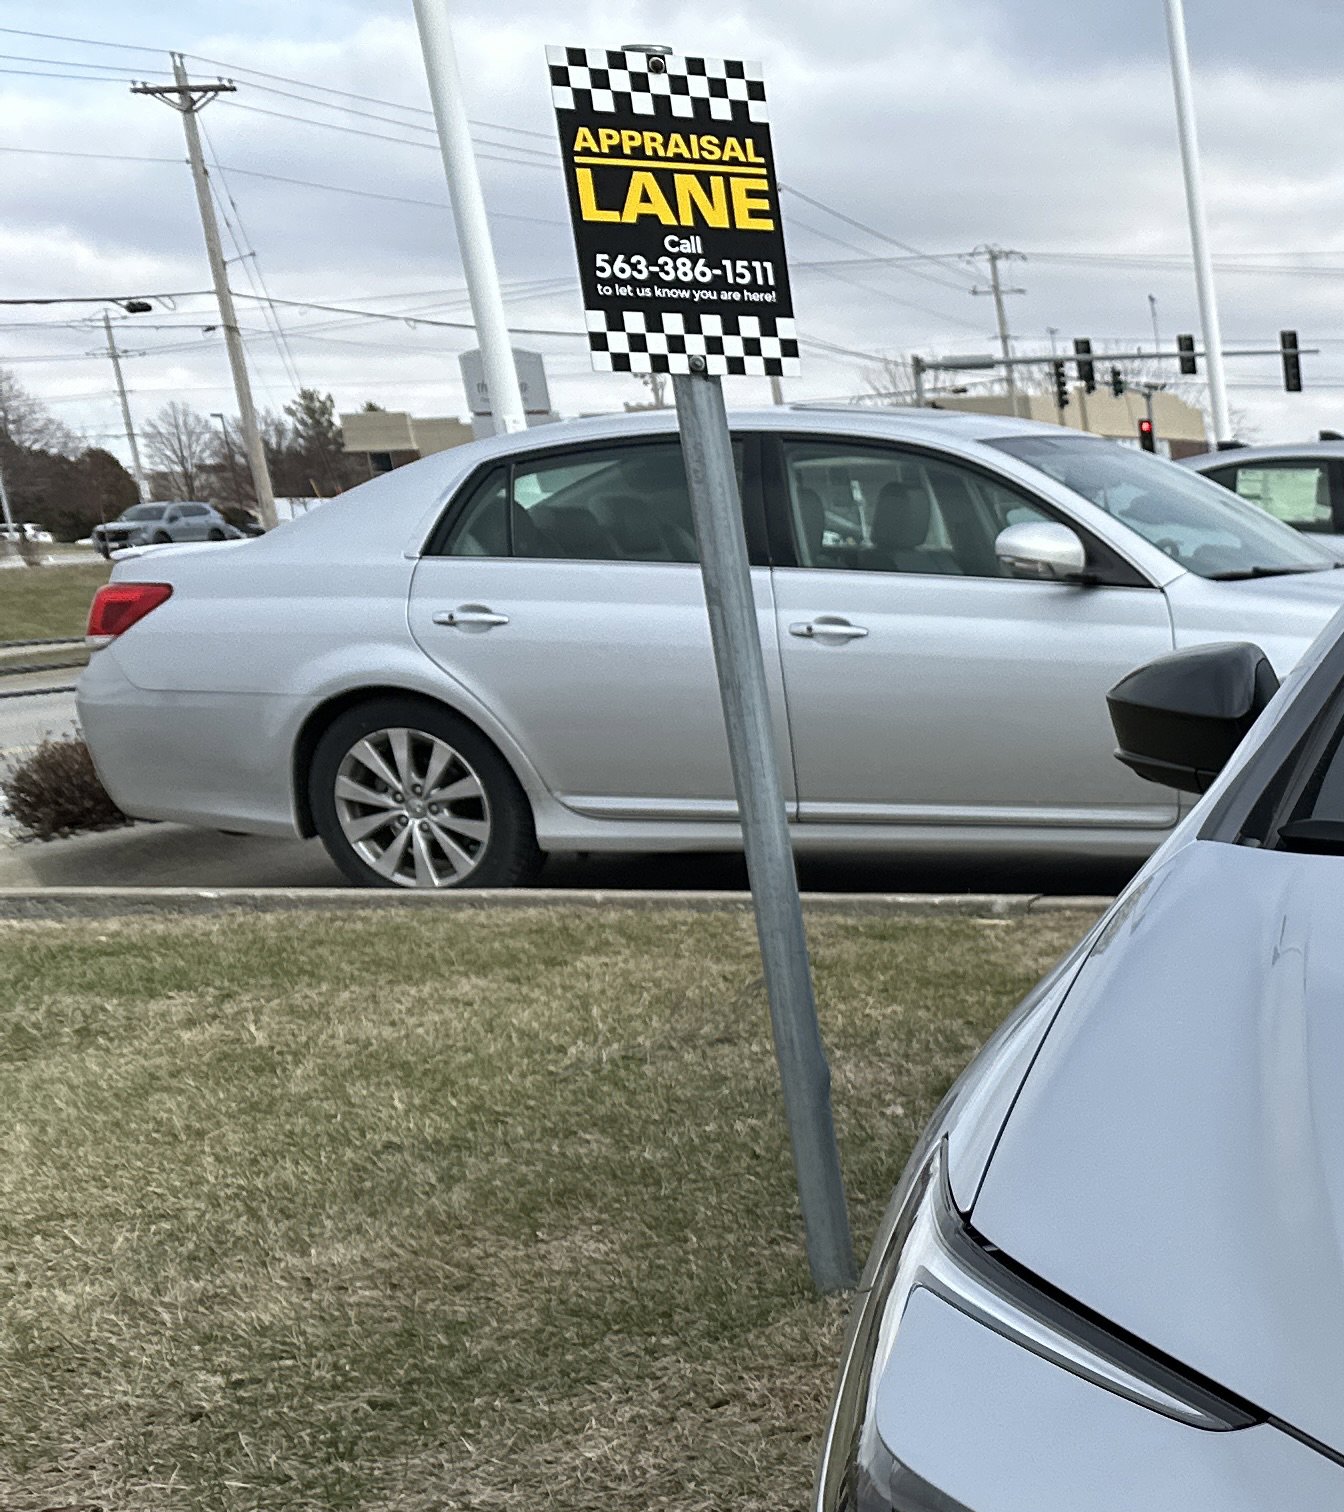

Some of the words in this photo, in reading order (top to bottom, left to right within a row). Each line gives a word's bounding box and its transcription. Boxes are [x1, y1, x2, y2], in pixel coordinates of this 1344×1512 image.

[573, 127, 765, 164] APPRAISAL
[576, 167, 775, 232] LANE
[663, 234, 703, 254] Call
[595, 253, 776, 286] 563-386-1511
[597, 283, 612, 296] to
[615, 284, 634, 296] let
[636, 286, 651, 297] us
[654, 285, 690, 299] know
[692, 289, 717, 301] you
[720, 290, 741, 301] are
[744, 289, 777, 303] here!
